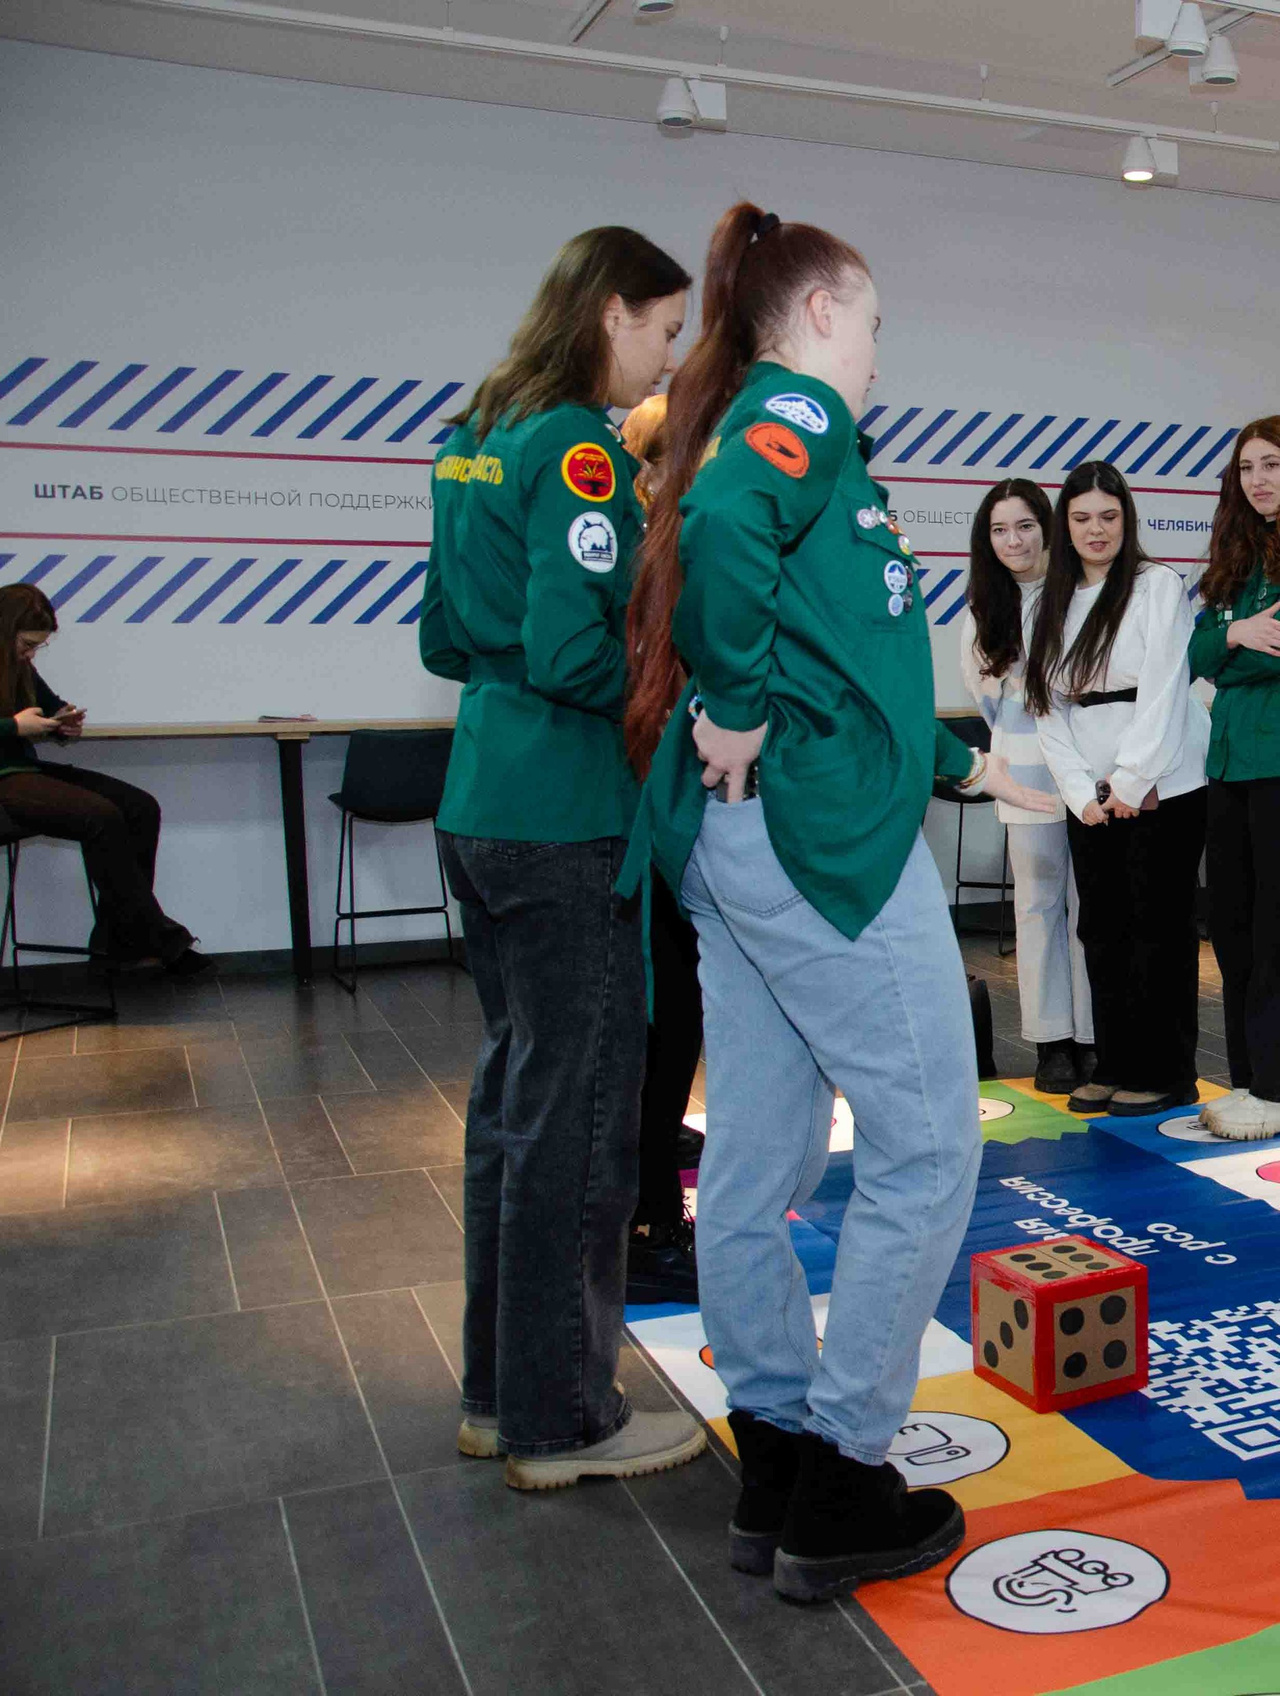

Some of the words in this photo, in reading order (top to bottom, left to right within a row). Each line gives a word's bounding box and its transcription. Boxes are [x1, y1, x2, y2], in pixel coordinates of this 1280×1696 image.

[34, 484, 104, 500] ШТАБ
[111, 486, 301, 506] ОБЩЕСТВЕННОЙ
[903, 510, 972, 526] ОБЩЕСТ
[1147, 519, 1213, 532] ЧЕЛЯБИН
[999, 1176, 1160, 1256] профессия
